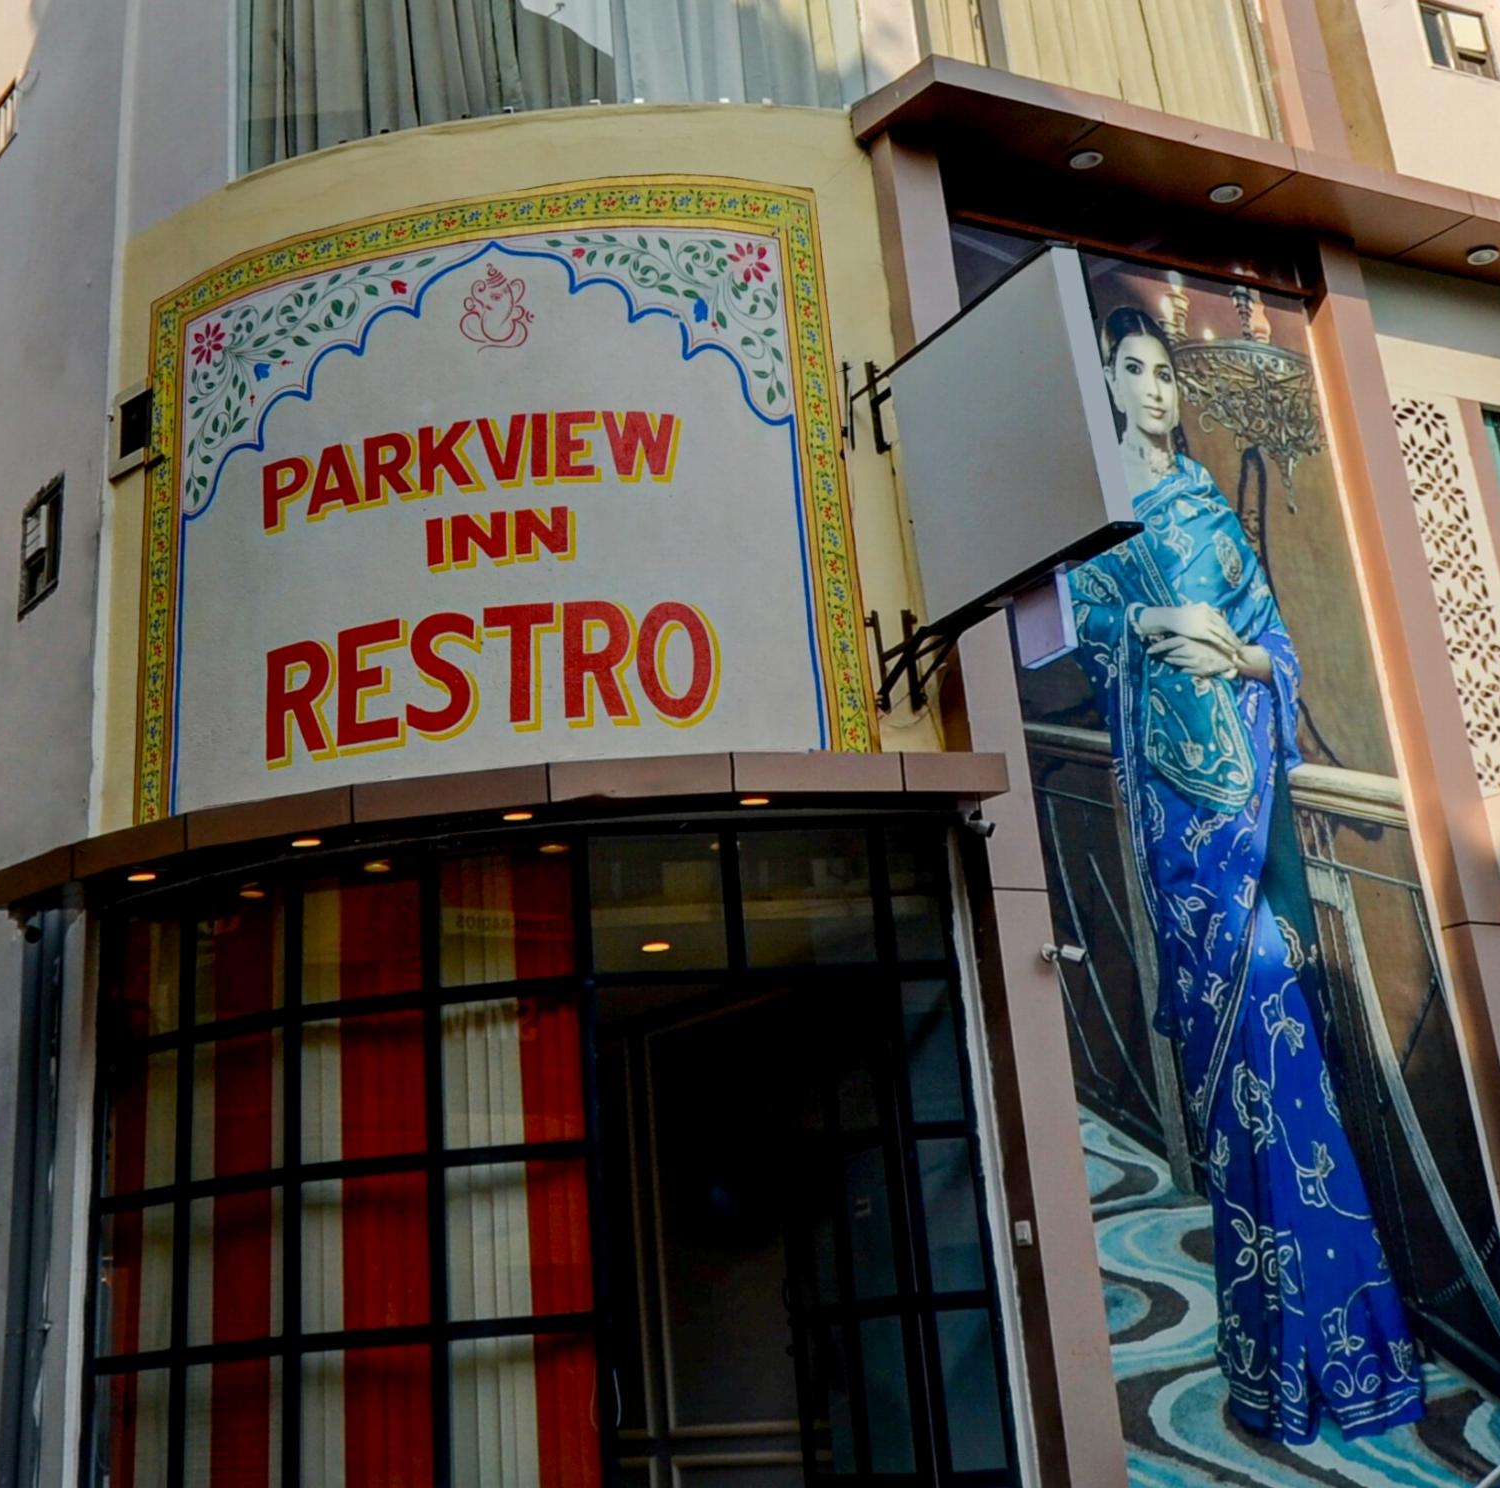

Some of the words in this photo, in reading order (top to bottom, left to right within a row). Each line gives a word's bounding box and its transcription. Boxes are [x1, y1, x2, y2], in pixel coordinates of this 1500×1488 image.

[262, 409, 681, 535] PARKVIEW
[425, 505, 577, 572] INN
[265, 600, 721, 769] RESTRO
